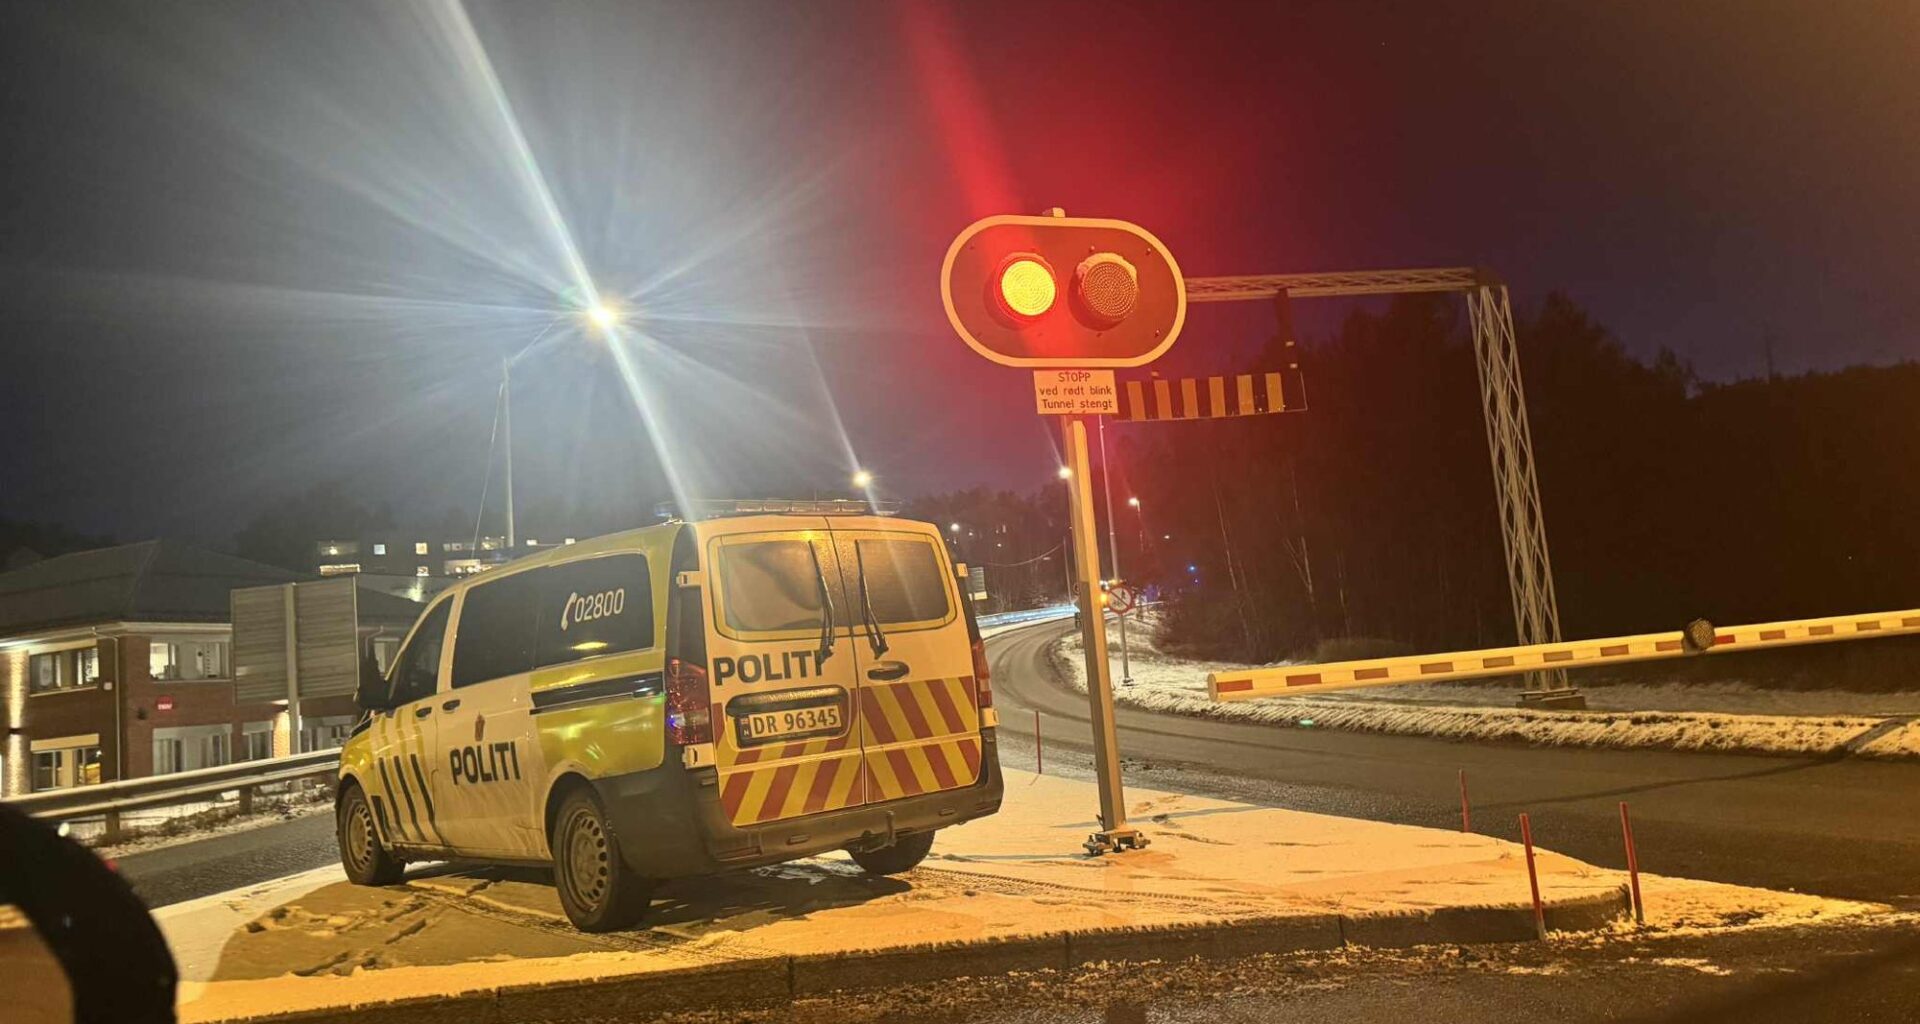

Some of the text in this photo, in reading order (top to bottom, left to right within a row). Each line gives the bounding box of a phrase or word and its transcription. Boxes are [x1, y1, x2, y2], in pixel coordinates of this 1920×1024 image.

[1058, 372, 1091, 382] STOPP
[1040, 386, 1112, 395] ved rødt blink
[1042, 399, 1113, 410] Tunnel stengt
[574, 588, 625, 622] 02800
[752, 715, 777, 735] DR
[783, 708, 838, 731] 96345
[449, 741, 521, 785] POLITI
